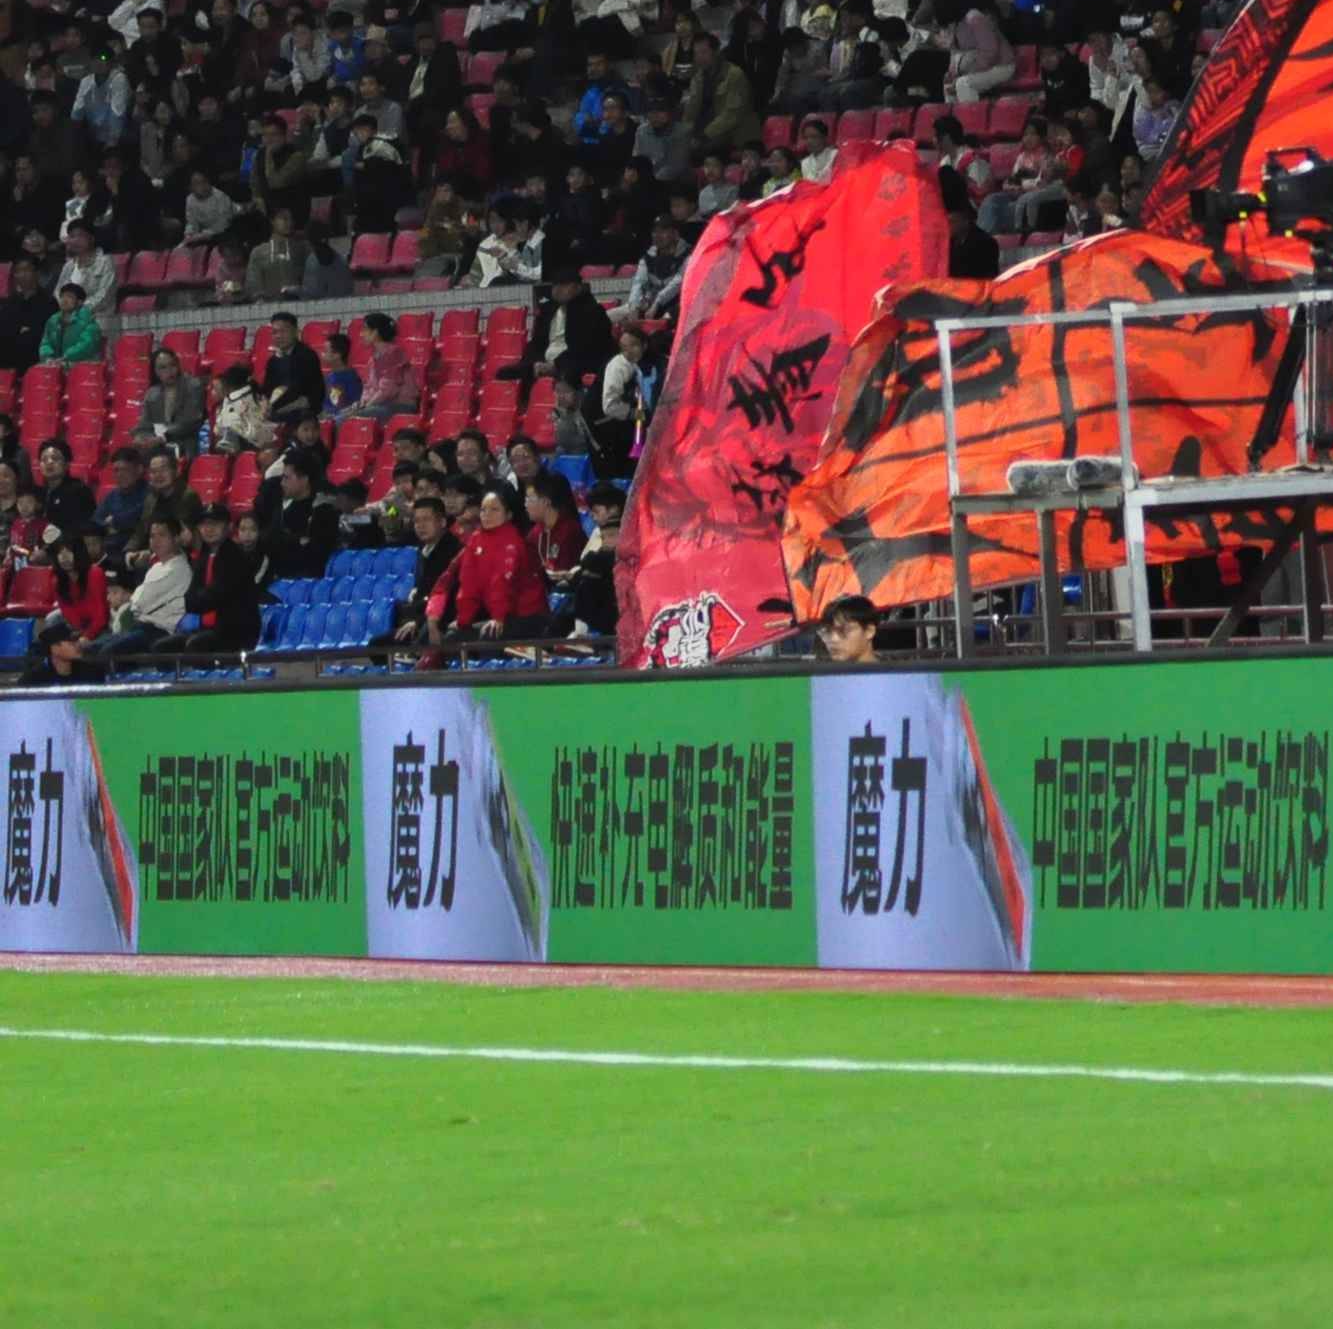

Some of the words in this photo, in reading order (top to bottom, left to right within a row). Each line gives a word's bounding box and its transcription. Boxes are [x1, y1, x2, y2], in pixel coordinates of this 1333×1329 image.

[4, 738, 64, 906] 魔力
[137, 752, 352, 903] 中国国家队官方运动饮料
[388, 729, 459, 910] 魔力
[549, 740, 796, 911] 快速补充电解质和能量
[841, 719, 928, 915] 魔力
[1032, 727, 1329, 911] 中国国家队官方运动饮料
